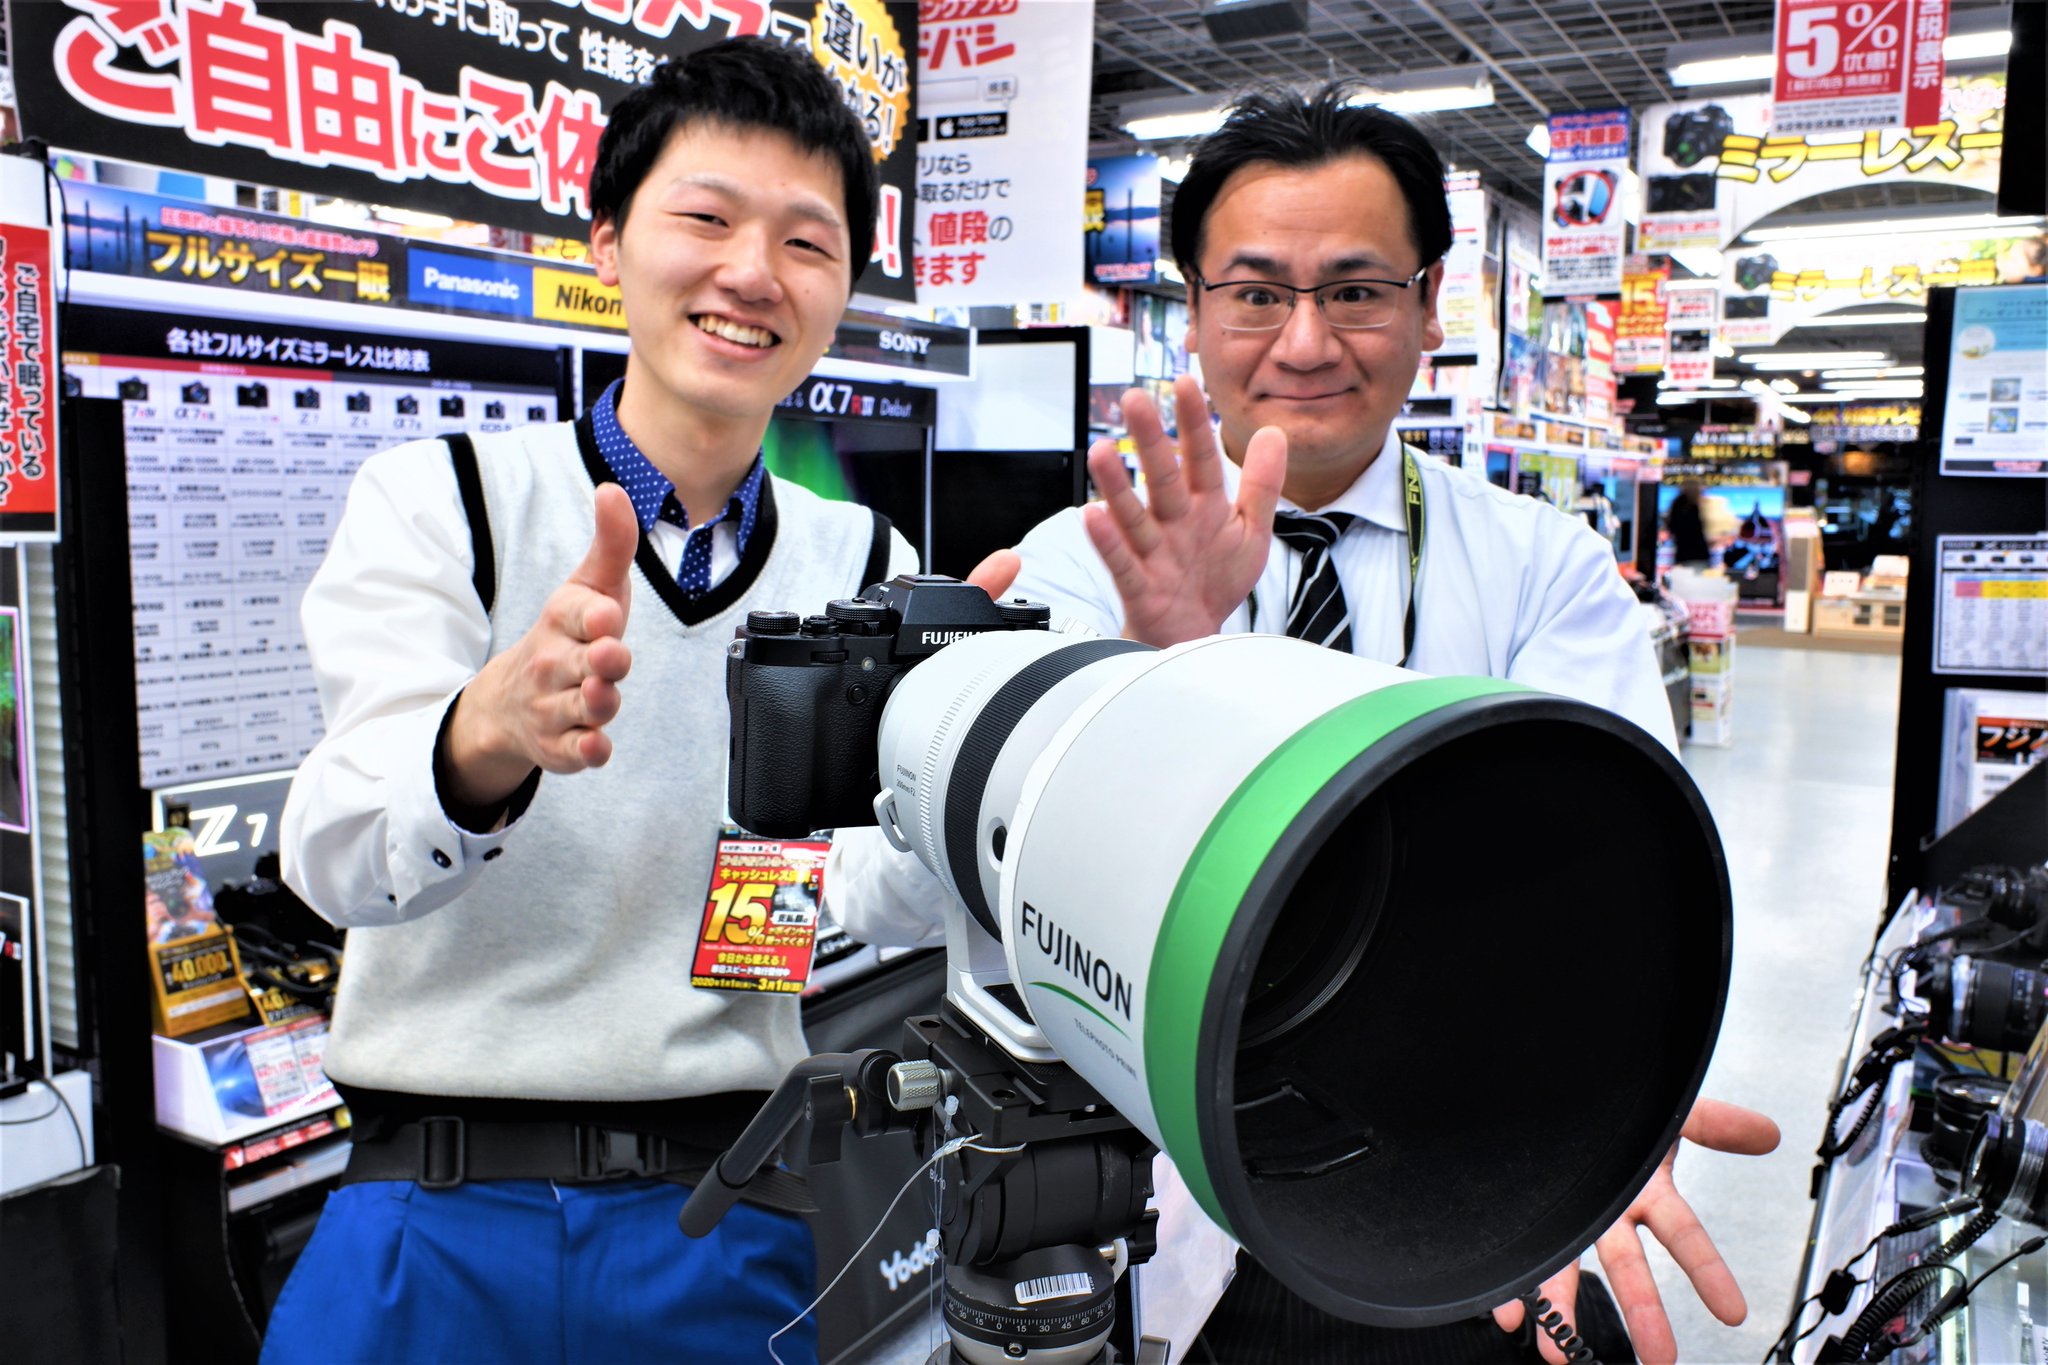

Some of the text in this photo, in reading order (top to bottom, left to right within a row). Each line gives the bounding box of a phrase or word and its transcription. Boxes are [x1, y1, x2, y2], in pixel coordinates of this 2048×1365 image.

[1785, 3, 1898, 79] 5%
[146, 230, 391, 302] フルサイズ一眼
[424, 266, 520, 300] Panasonic
[556, 284, 622, 317] Nikon
[166, 327, 431, 373] 各社フルサイズミラーレス比較表
[879, 330, 930, 355] SONY
[14, 261, 42, 480] ご自宅で眠っている
[921, 631, 982, 645] FUJIF
[1022, 900, 1132, 1021] FUJINON
[1016, 1325, 1027, 1333] 15
[1039, 1324, 1050, 1333] 30
[1061, 1321, 1072, 1330] 45
